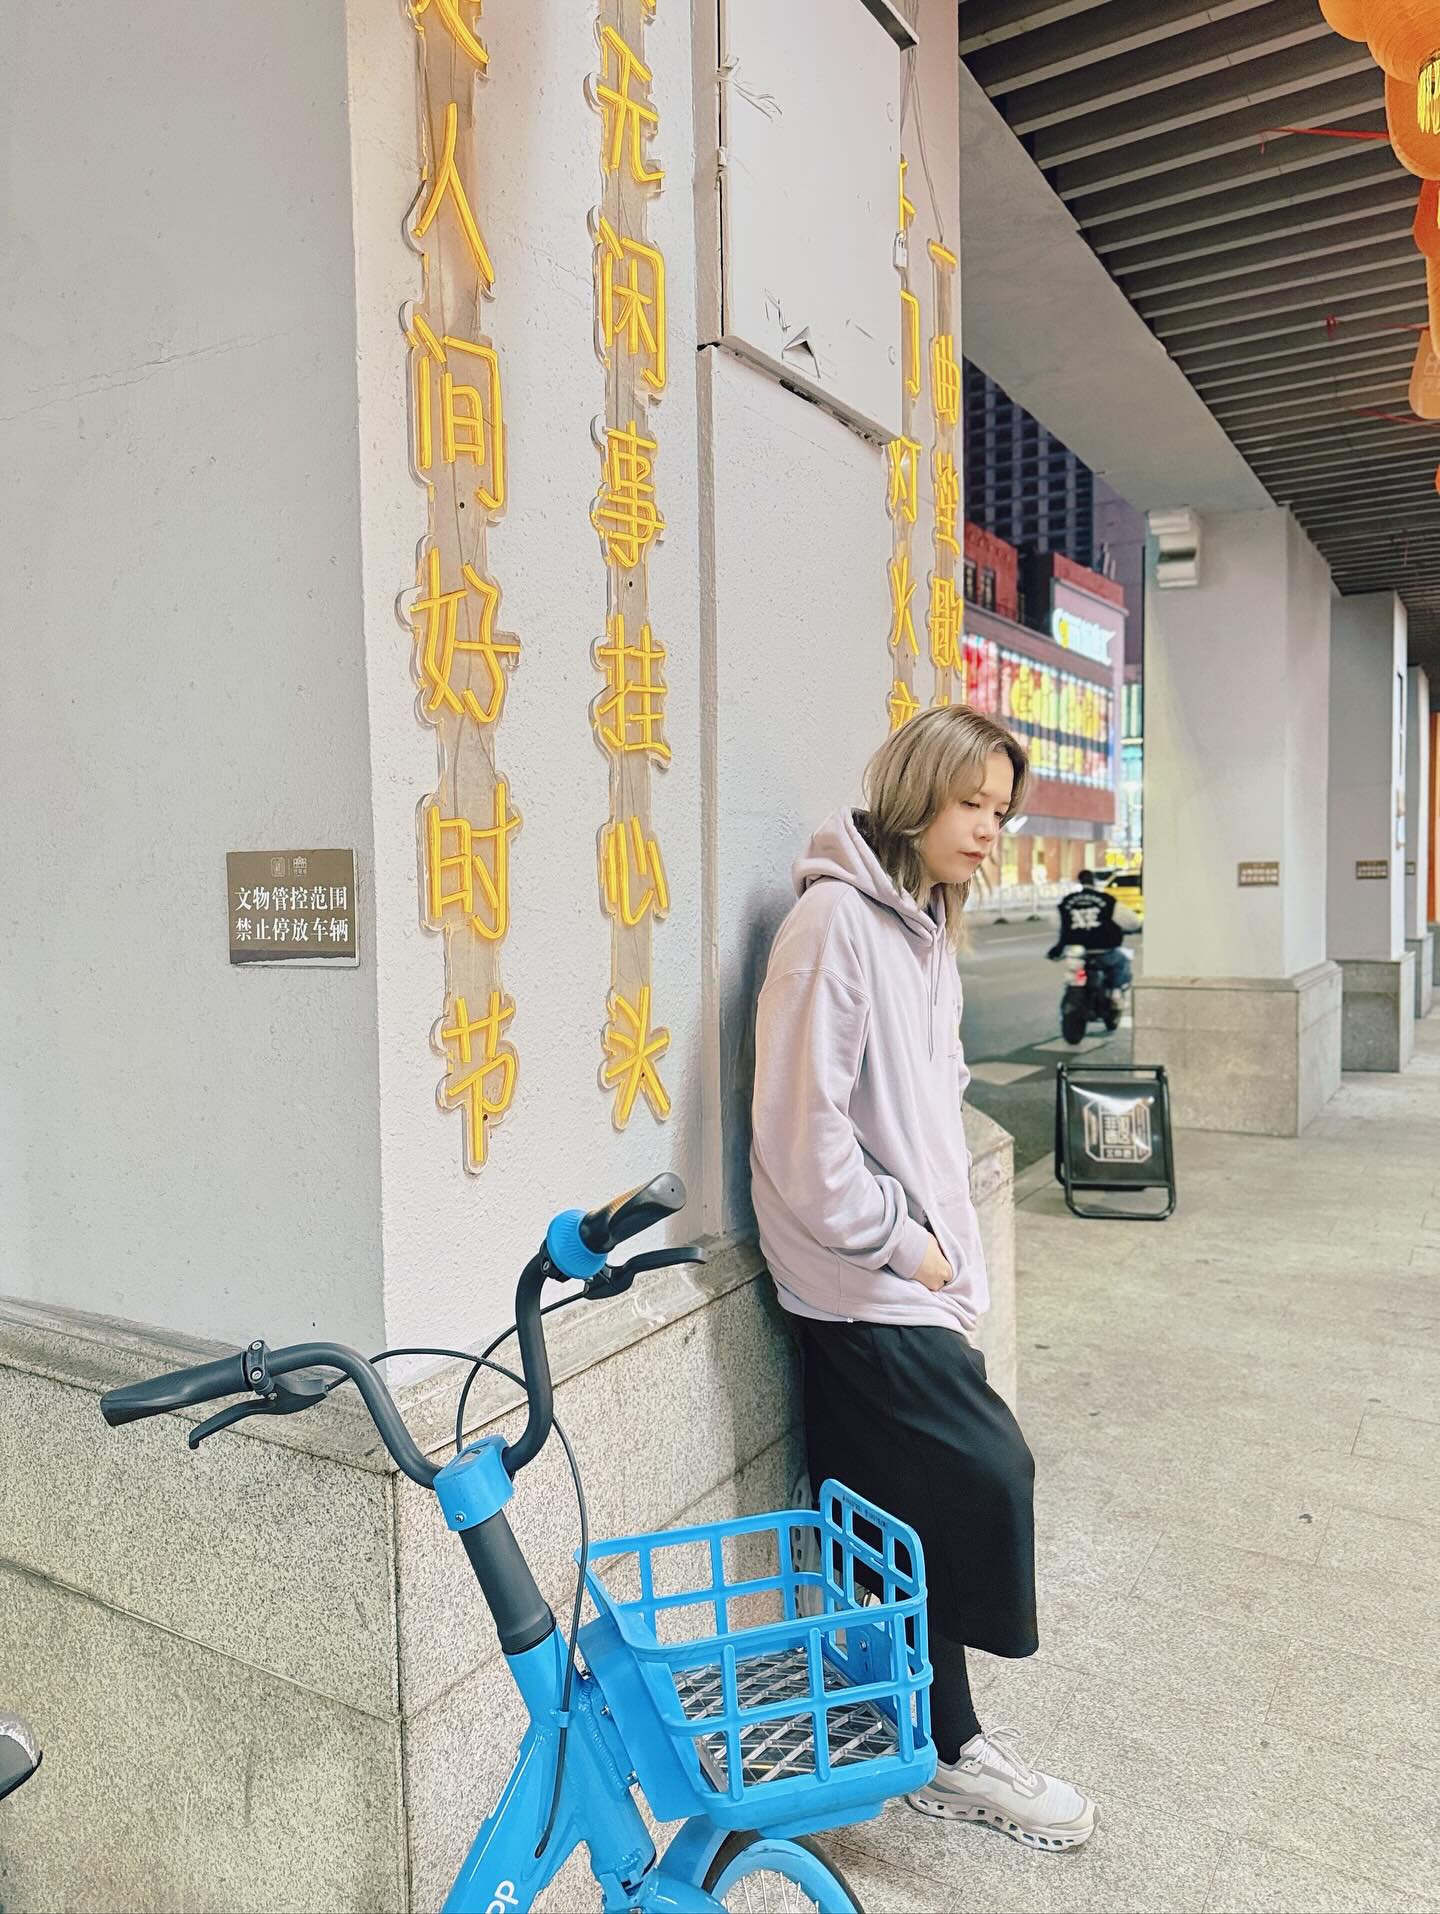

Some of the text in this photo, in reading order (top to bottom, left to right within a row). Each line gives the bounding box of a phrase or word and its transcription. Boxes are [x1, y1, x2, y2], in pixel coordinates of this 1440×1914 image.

[594, 0, 671, 1122] 无闲事挂心头
[930, 243, 964, 705] 一曲笙歌
[235, 886, 347, 911] 文物管控范围
[235, 917, 349, 942] 禁止停放车辆
